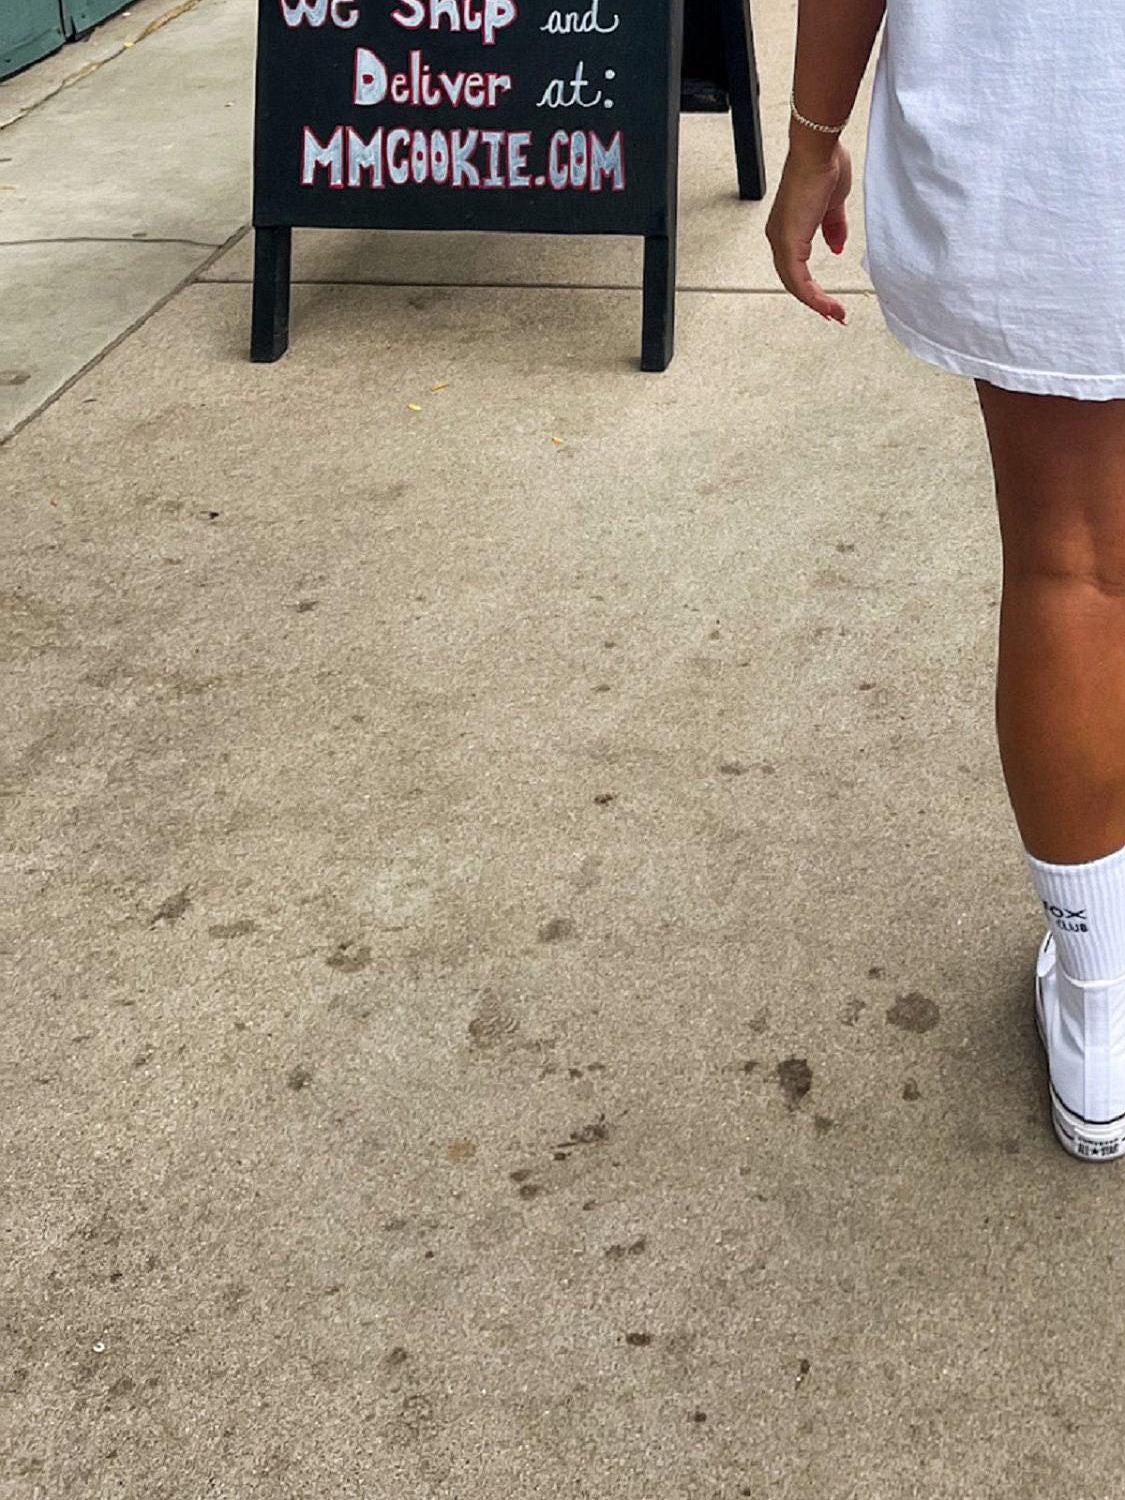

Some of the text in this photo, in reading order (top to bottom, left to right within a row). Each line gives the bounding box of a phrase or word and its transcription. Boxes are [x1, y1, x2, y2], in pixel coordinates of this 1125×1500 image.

[352, 47, 617, 110] Deliver at:
[300, 125, 627, 192] MMCOOKIE.COM
